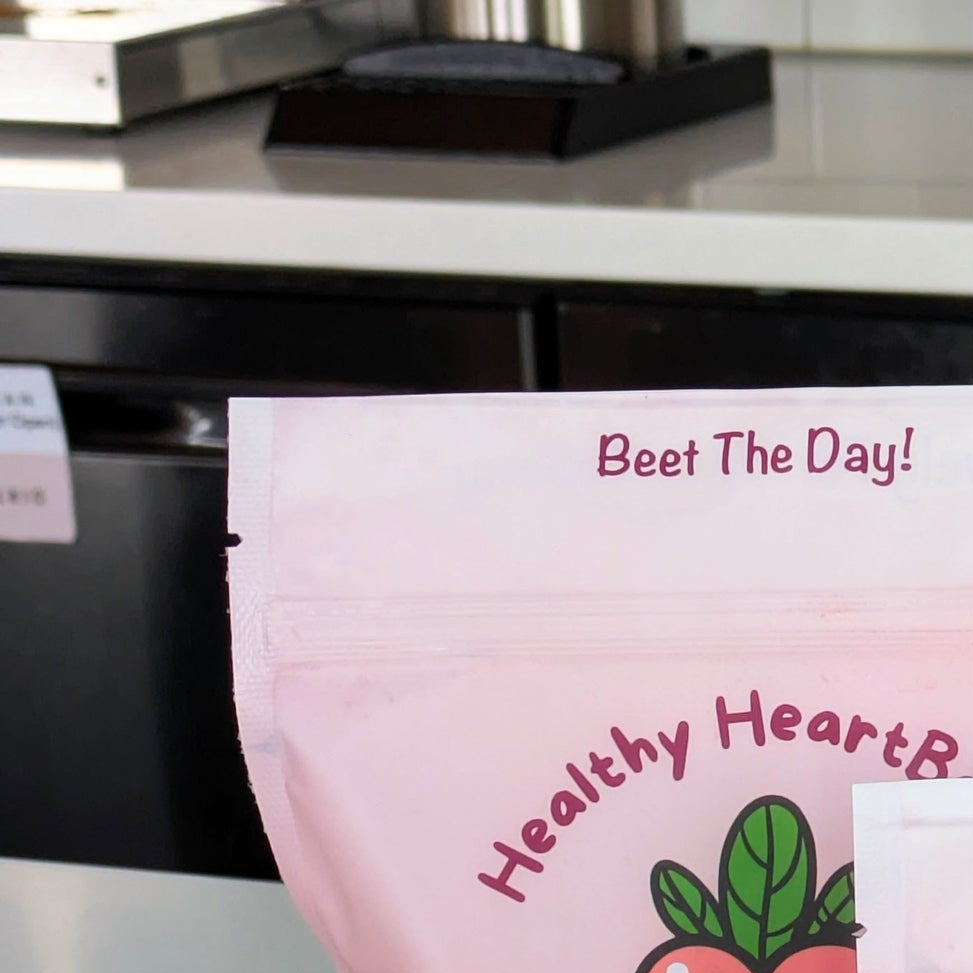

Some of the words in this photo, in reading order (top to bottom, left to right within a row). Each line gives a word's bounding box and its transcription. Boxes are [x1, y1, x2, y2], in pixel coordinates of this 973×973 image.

[597, 433, 699, 477] Beet
[713, 430, 793, 475] The
[807, 427, 914, 487] Day!
[477, 721, 690, 903] Healthy
[716, 690, 973, 780] HeartB
